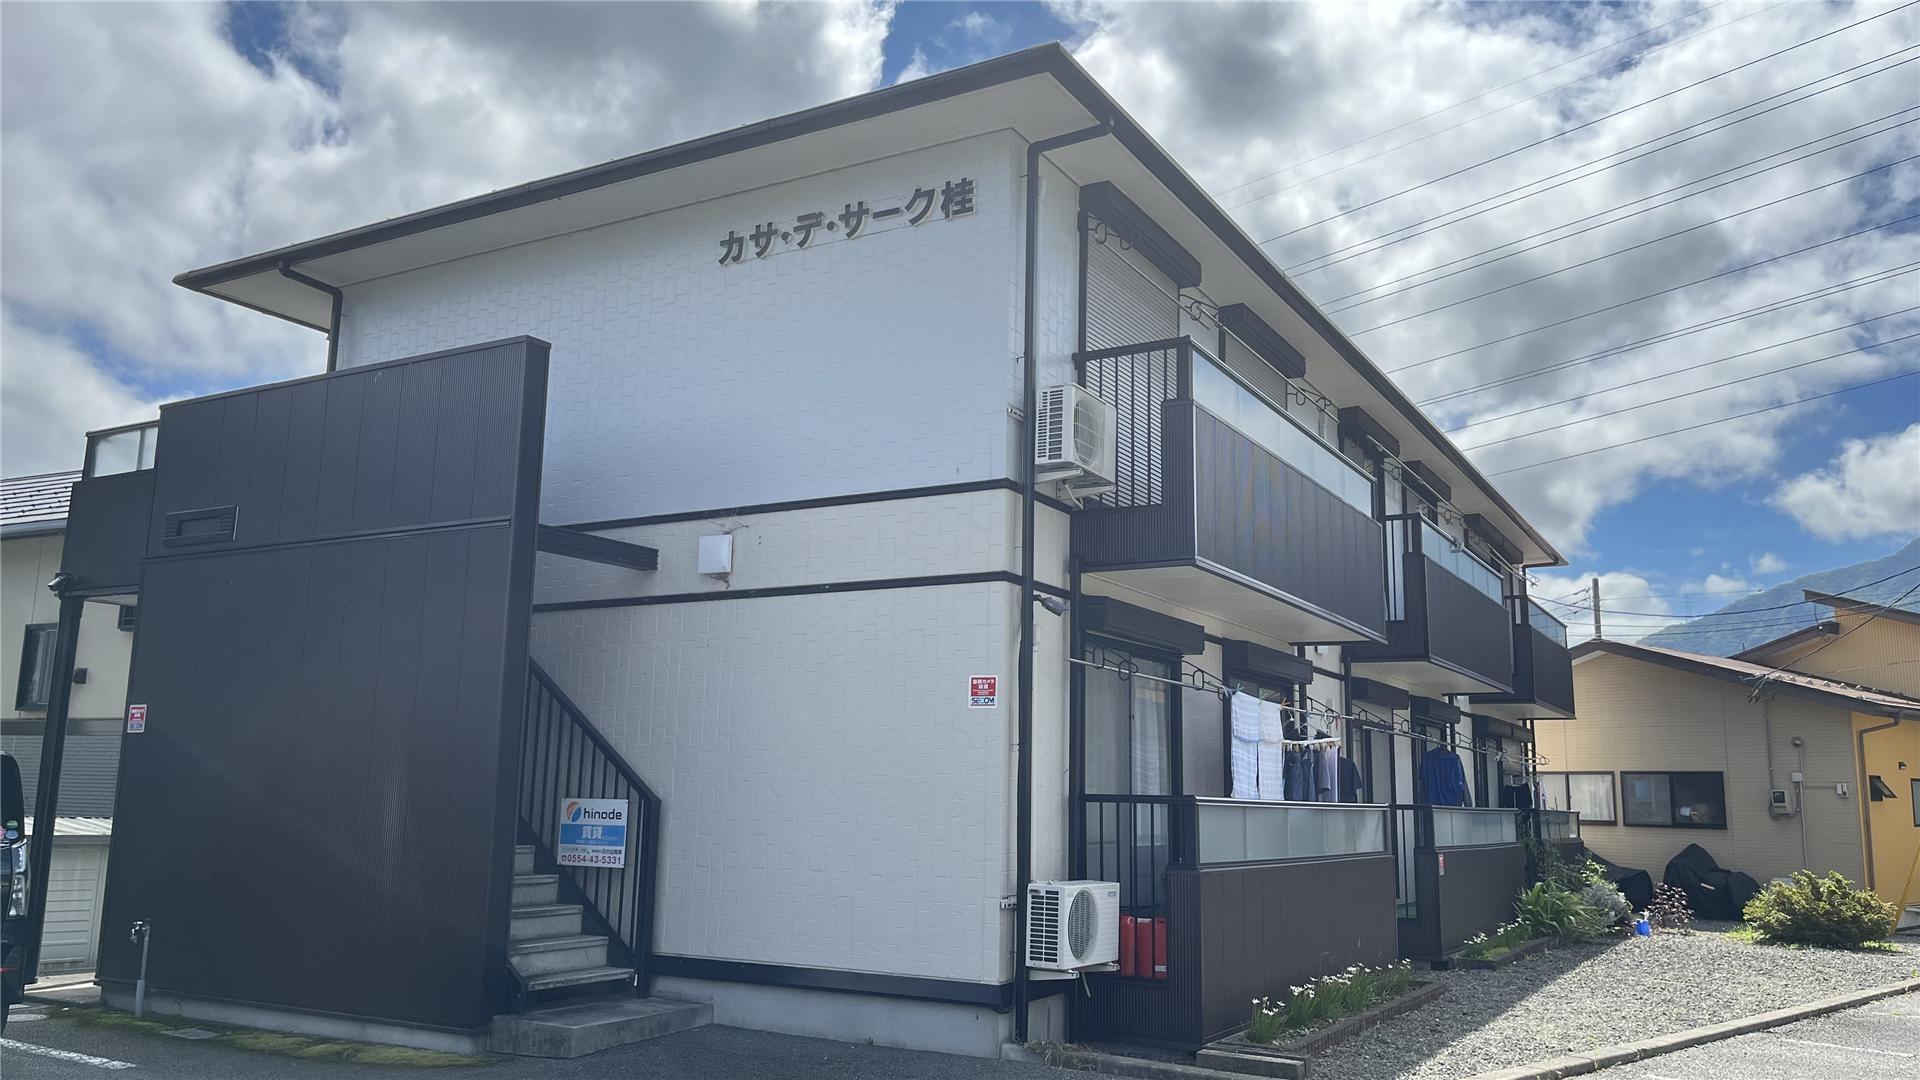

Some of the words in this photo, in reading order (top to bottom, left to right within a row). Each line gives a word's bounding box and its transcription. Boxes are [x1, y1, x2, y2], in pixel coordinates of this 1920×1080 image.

[718, 177, 975, 266] カサ・デ・サーク桂
[583, 808, 622, 820] hinode
